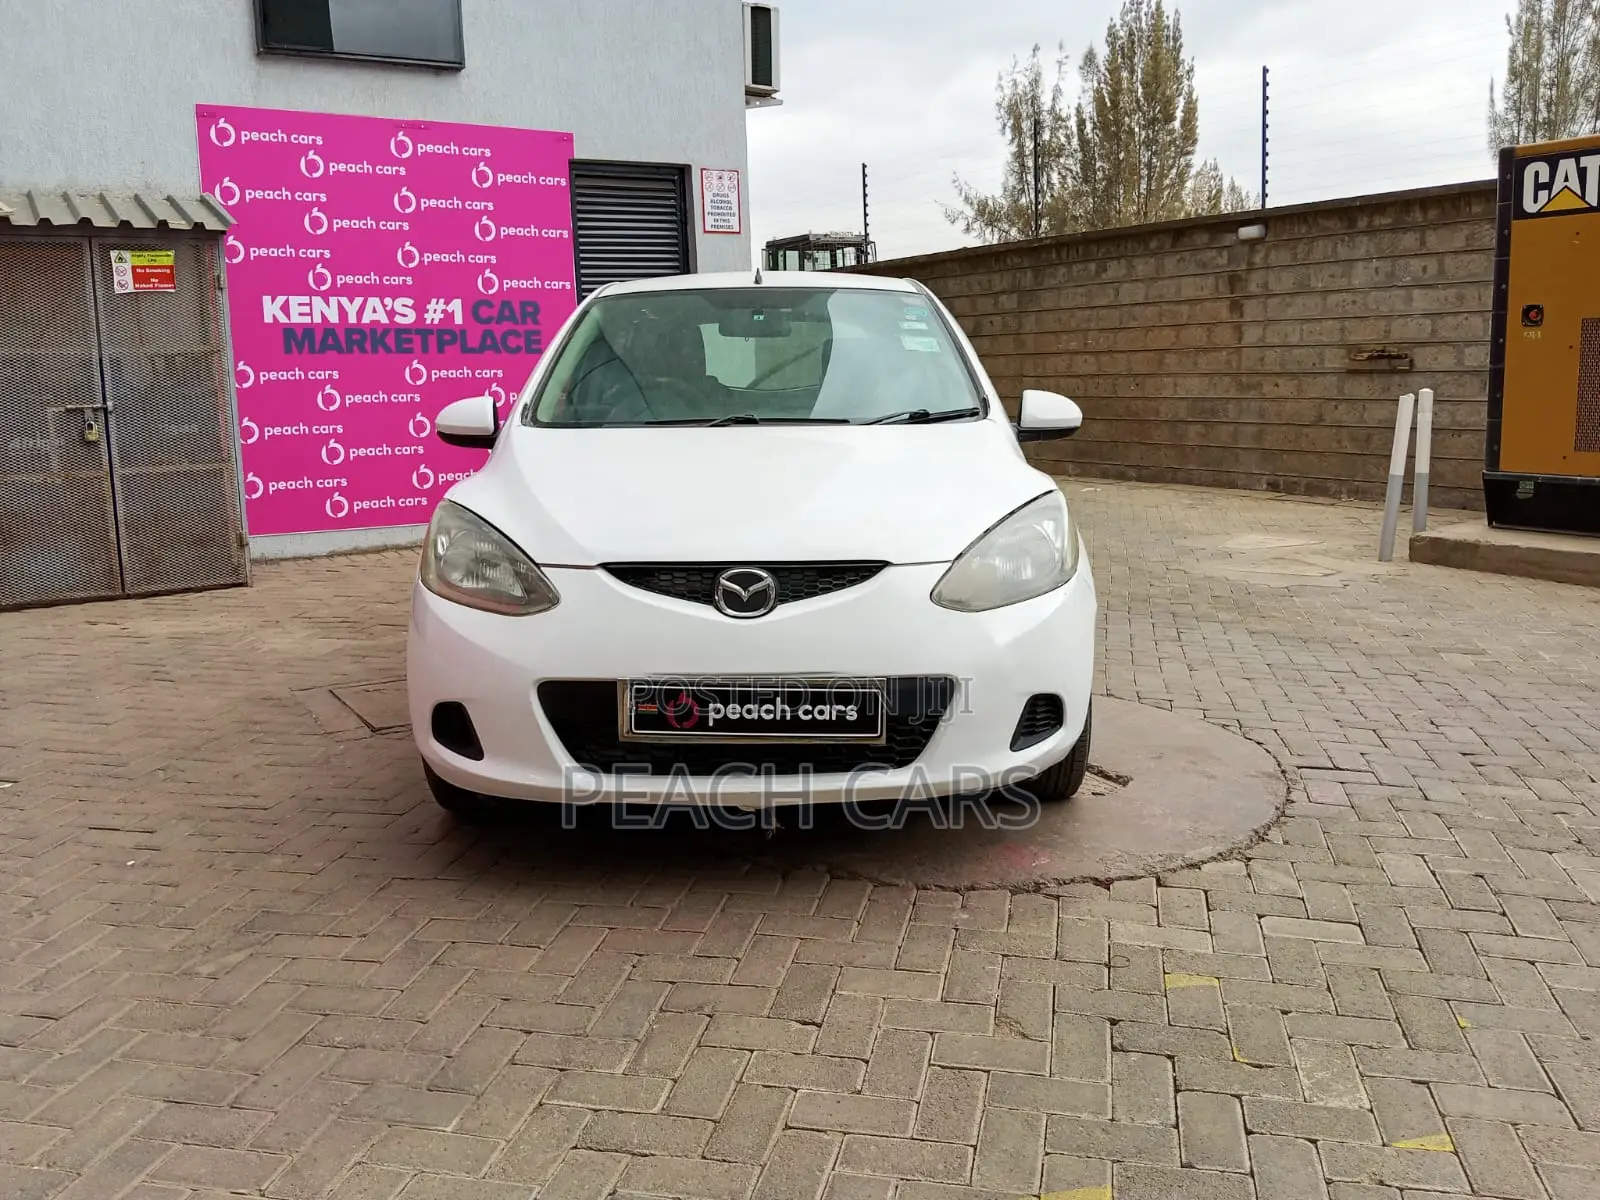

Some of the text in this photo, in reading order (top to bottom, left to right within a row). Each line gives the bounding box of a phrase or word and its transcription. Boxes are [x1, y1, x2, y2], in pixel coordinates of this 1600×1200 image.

[241, 128, 323, 145] peach cars
[418, 142, 491, 157] peach cars
[329, 160, 406, 175] peach cars
[498, 171, 566, 186] peach cars
[1522, 154, 1600, 213] CAT
[245, 187, 327, 202] peach cars
[421, 196, 493, 211] peach cars
[333, 216, 409, 231] peach cars
[500, 224, 569, 239] peach cars
[250, 244, 330, 260] peach cars
[424, 250, 496, 265] peach cars
[337, 272, 412, 287] peach cars
[503, 276, 571, 291] peach cars
[263, 295, 540, 325] KENYA'S #1 CAR
[283, 327, 542, 355] MARKETPLACE
[260, 368, 339, 384] peach cars
[432, 365, 503, 381] peach cars
[346, 391, 420, 407] peach cars
[265, 423, 343, 440] peach cars
[350, 443, 425, 460] peach cars
[269, 476, 347, 494] peach cars
[354, 495, 427, 513] peach cars
[709, 697, 858, 726] peach cars
